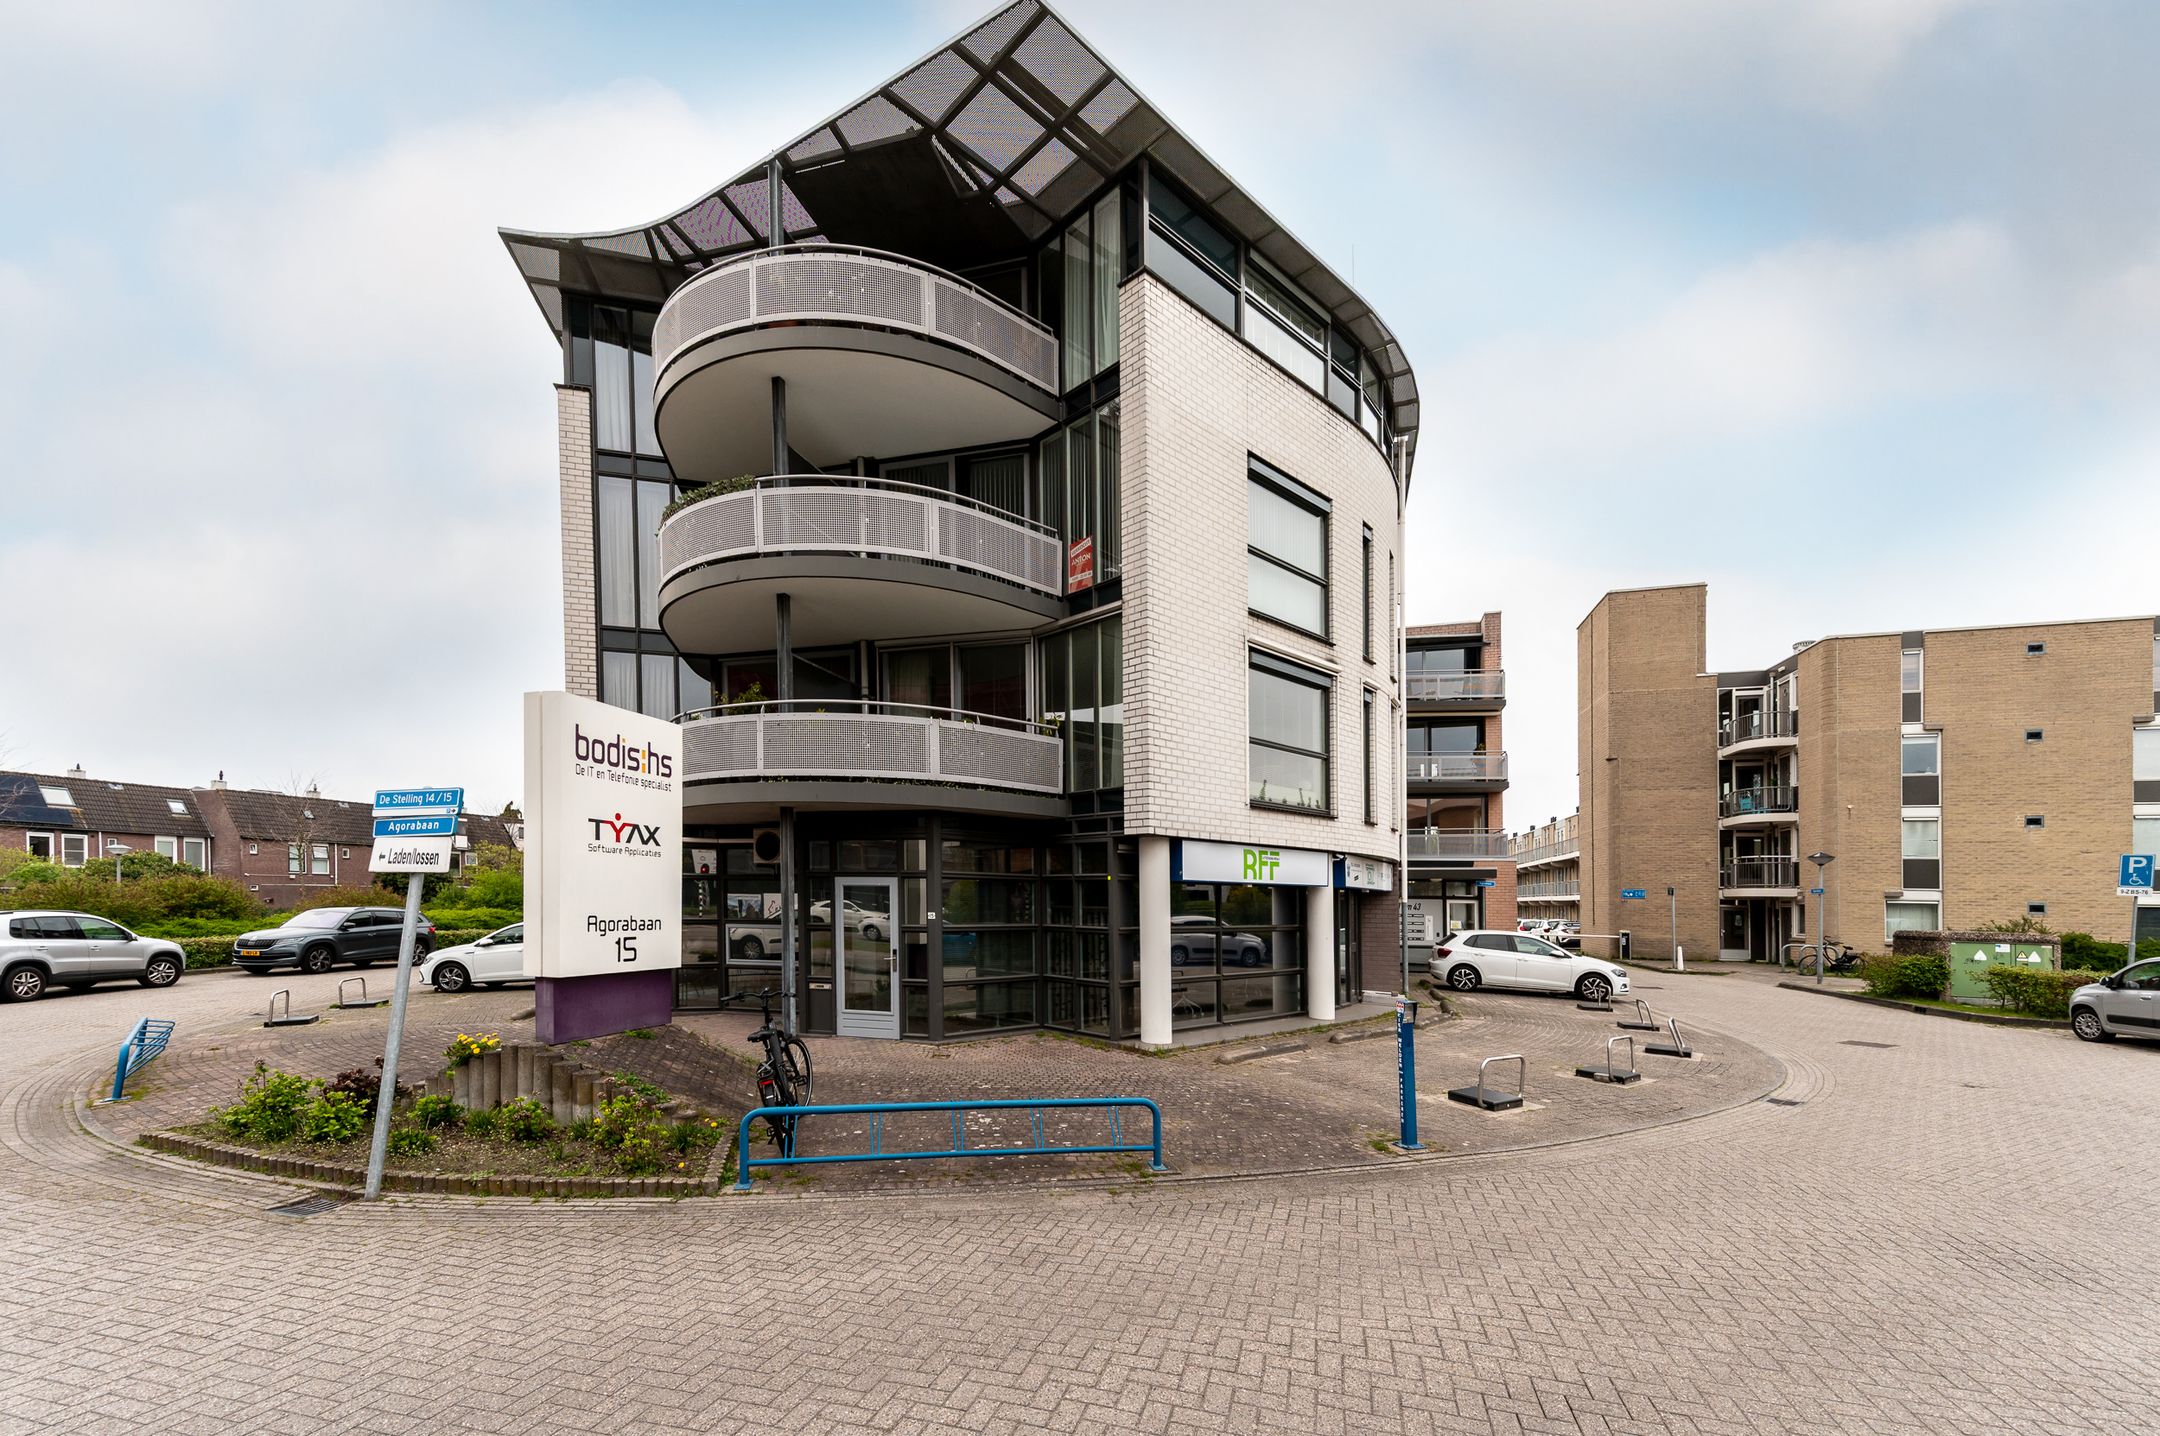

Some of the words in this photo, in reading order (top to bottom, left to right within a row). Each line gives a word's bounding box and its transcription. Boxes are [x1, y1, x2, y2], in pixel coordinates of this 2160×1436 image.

[576, 763, 586, 776] De
[586, 766, 594, 778] IT
[596, 770, 605, 779] en
[607, 769, 639, 786] Telefonie
[640, 778, 671, 792] specialist
[379, 794, 390, 804] De
[393, 793, 423, 806] Stelling
[388, 820, 439, 833] Agorabaan
[388, 847, 439, 865] Laden/lossen
[588, 843, 623, 855] Software
[624, 846, 662, 858] Applicaties
[1243, 848, 1280, 881] RFF
[2129, 857, 2147, 873] P
[1413, 902, 1421, 911] 43
[587, 915, 662, 936] Agorabaan
[615, 936, 637, 962] 15
